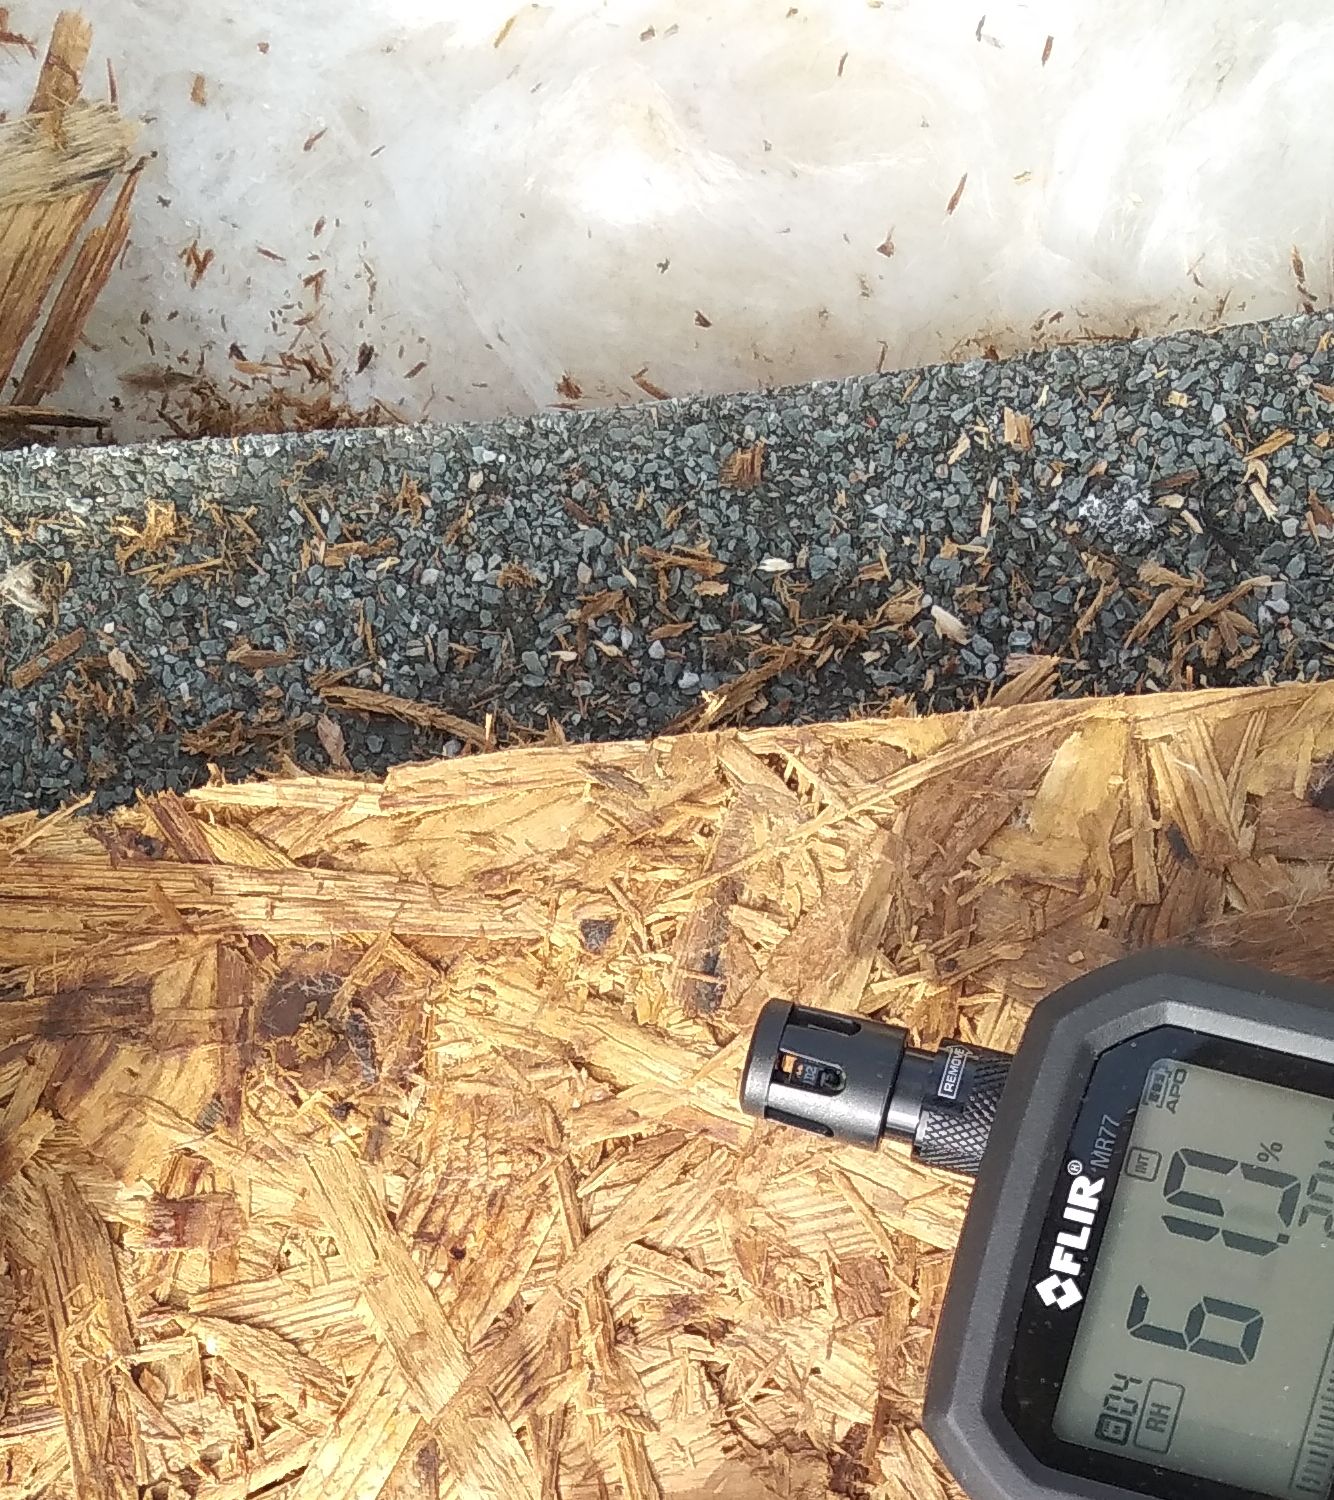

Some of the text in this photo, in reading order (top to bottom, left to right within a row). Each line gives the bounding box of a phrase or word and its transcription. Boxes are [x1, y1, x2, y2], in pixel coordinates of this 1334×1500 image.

[943, 1047, 965, 1093] REMOVE
[1167, 1068, 1188, 1114] APO
[1089, 1114, 1120, 1169] MR77
[1134, 1153, 1150, 1174] INT
[1145, 1402, 1172, 1433] RH
